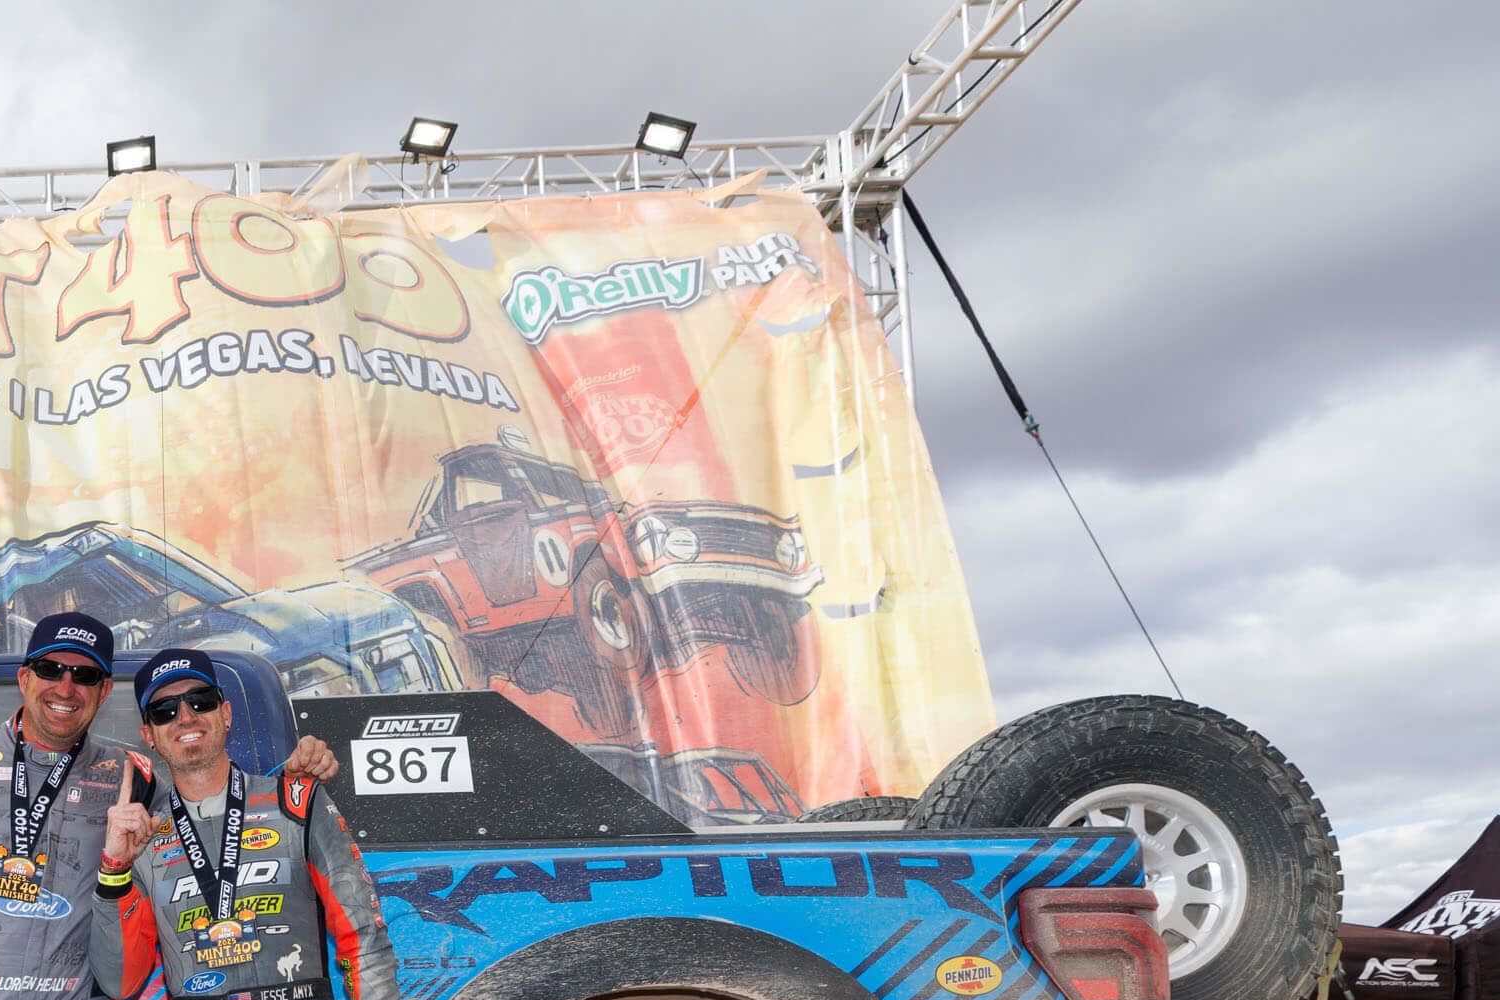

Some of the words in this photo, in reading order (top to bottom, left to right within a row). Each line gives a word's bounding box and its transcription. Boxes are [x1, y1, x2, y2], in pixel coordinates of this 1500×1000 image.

[716, 232, 801, 267] AUTO
[510, 264, 692, 336] O'Reilly
[33, 363, 132, 425] LAS
[140, 327, 334, 394] VEGAS,
[338, 333, 523, 413] NEVADA
[538, 537, 567, 575] 11
[57, 626, 98, 643] FORD
[152, 658, 192, 678] FORD
[366, 747, 457, 785] 867
[14, 808, 28, 835] 400
[31, 795, 50, 822] 400
[227, 808, 242, 835] 400
[177, 815, 197, 846] MINT
[187, 844, 206, 870] 400
[222, 834, 240, 869] MINT
[7, 872, 27, 883] 2025
[220, 883, 232, 920] UNLTD
[368, 851, 1006, 938] RAPTOR
[197, 945, 232, 962] MINT
[232, 939, 261, 955] 400
[218, 937, 237, 947] 2025
[208, 953, 253, 968] FINISHER
[38, 977, 68, 992] HEALY
[66, 977, 80, 991] 67
[191, 974, 217, 991] Ford
[945, 966, 994, 985] PENNZOIL
[292, 984, 314, 1000] AMYX
